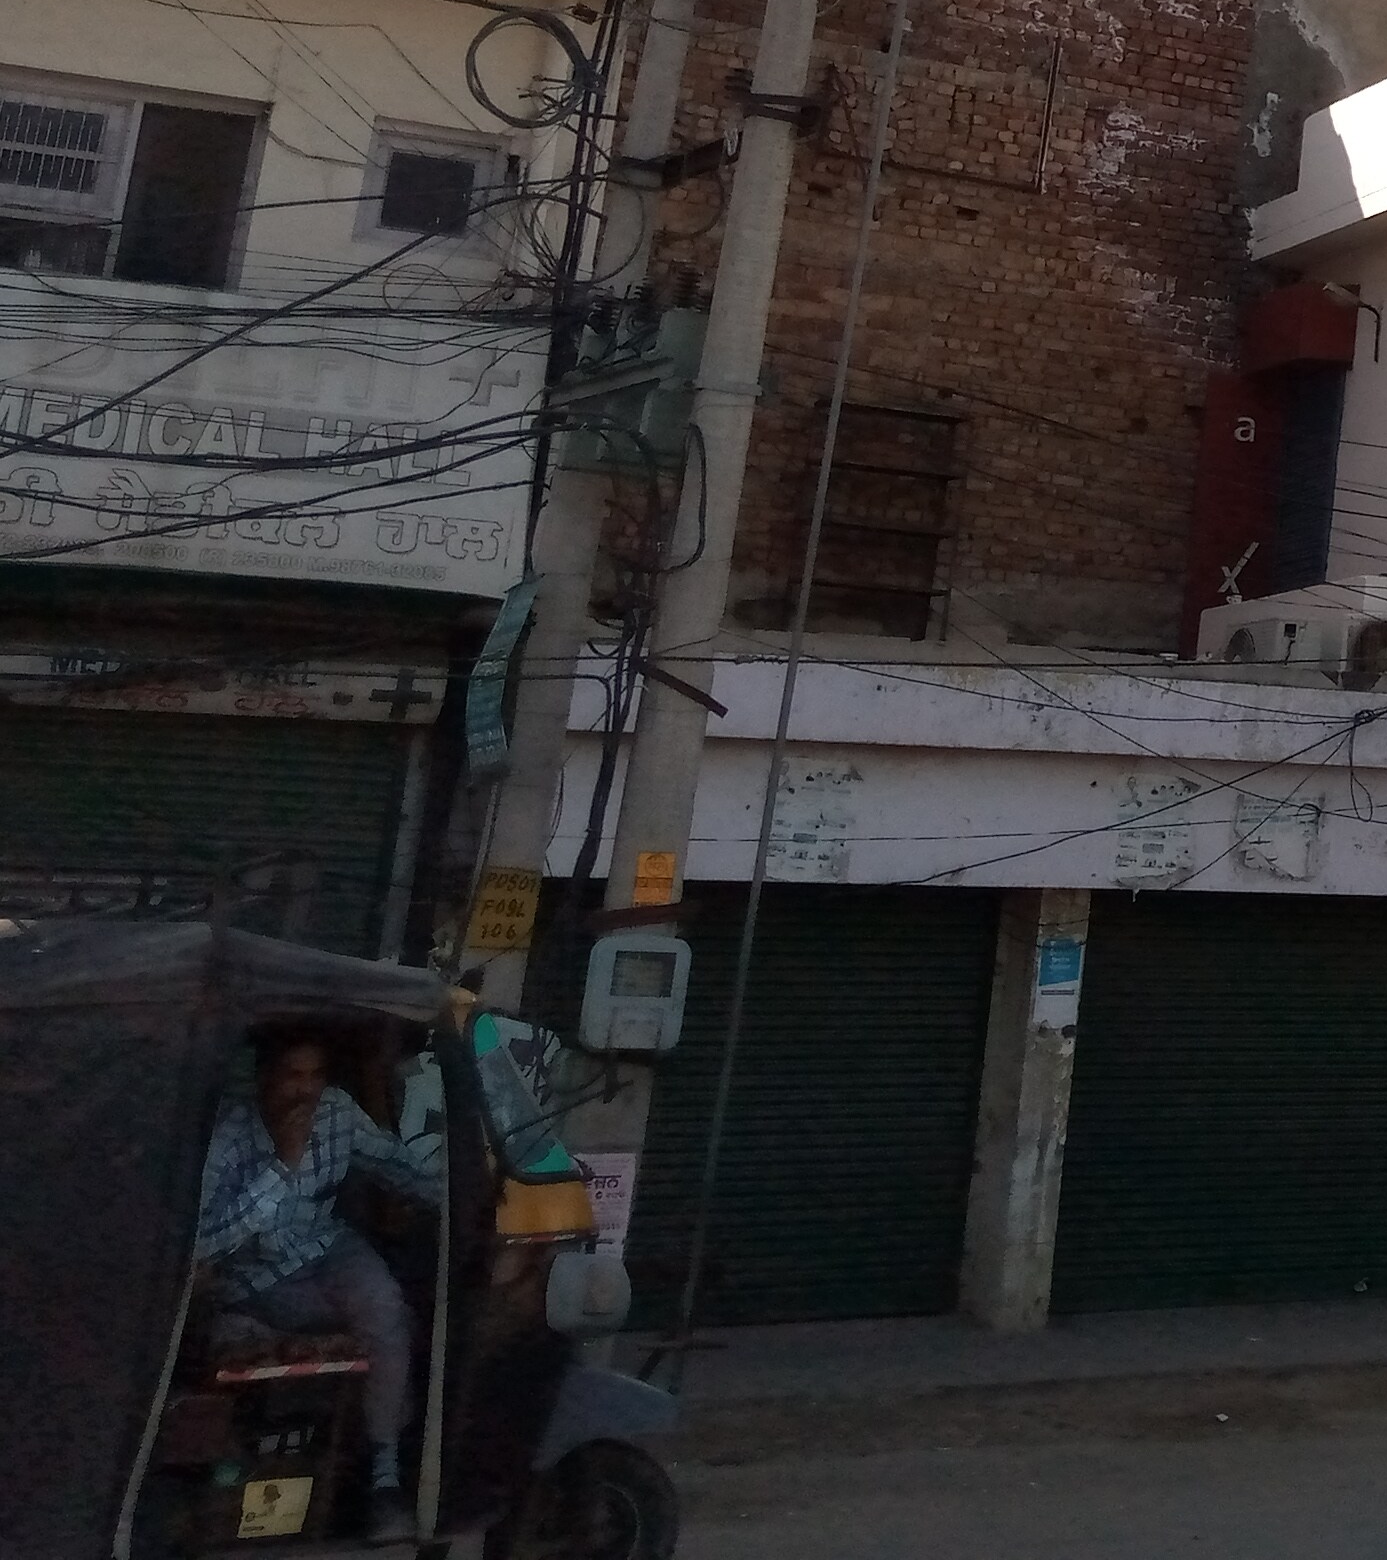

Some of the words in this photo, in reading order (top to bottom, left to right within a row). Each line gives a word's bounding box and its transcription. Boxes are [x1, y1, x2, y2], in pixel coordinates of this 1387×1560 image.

[0, 386, 281, 461] MEDICAL
[305, 415, 472, 488] HALL
[375, 510, 504, 561] ਹਾਲ
